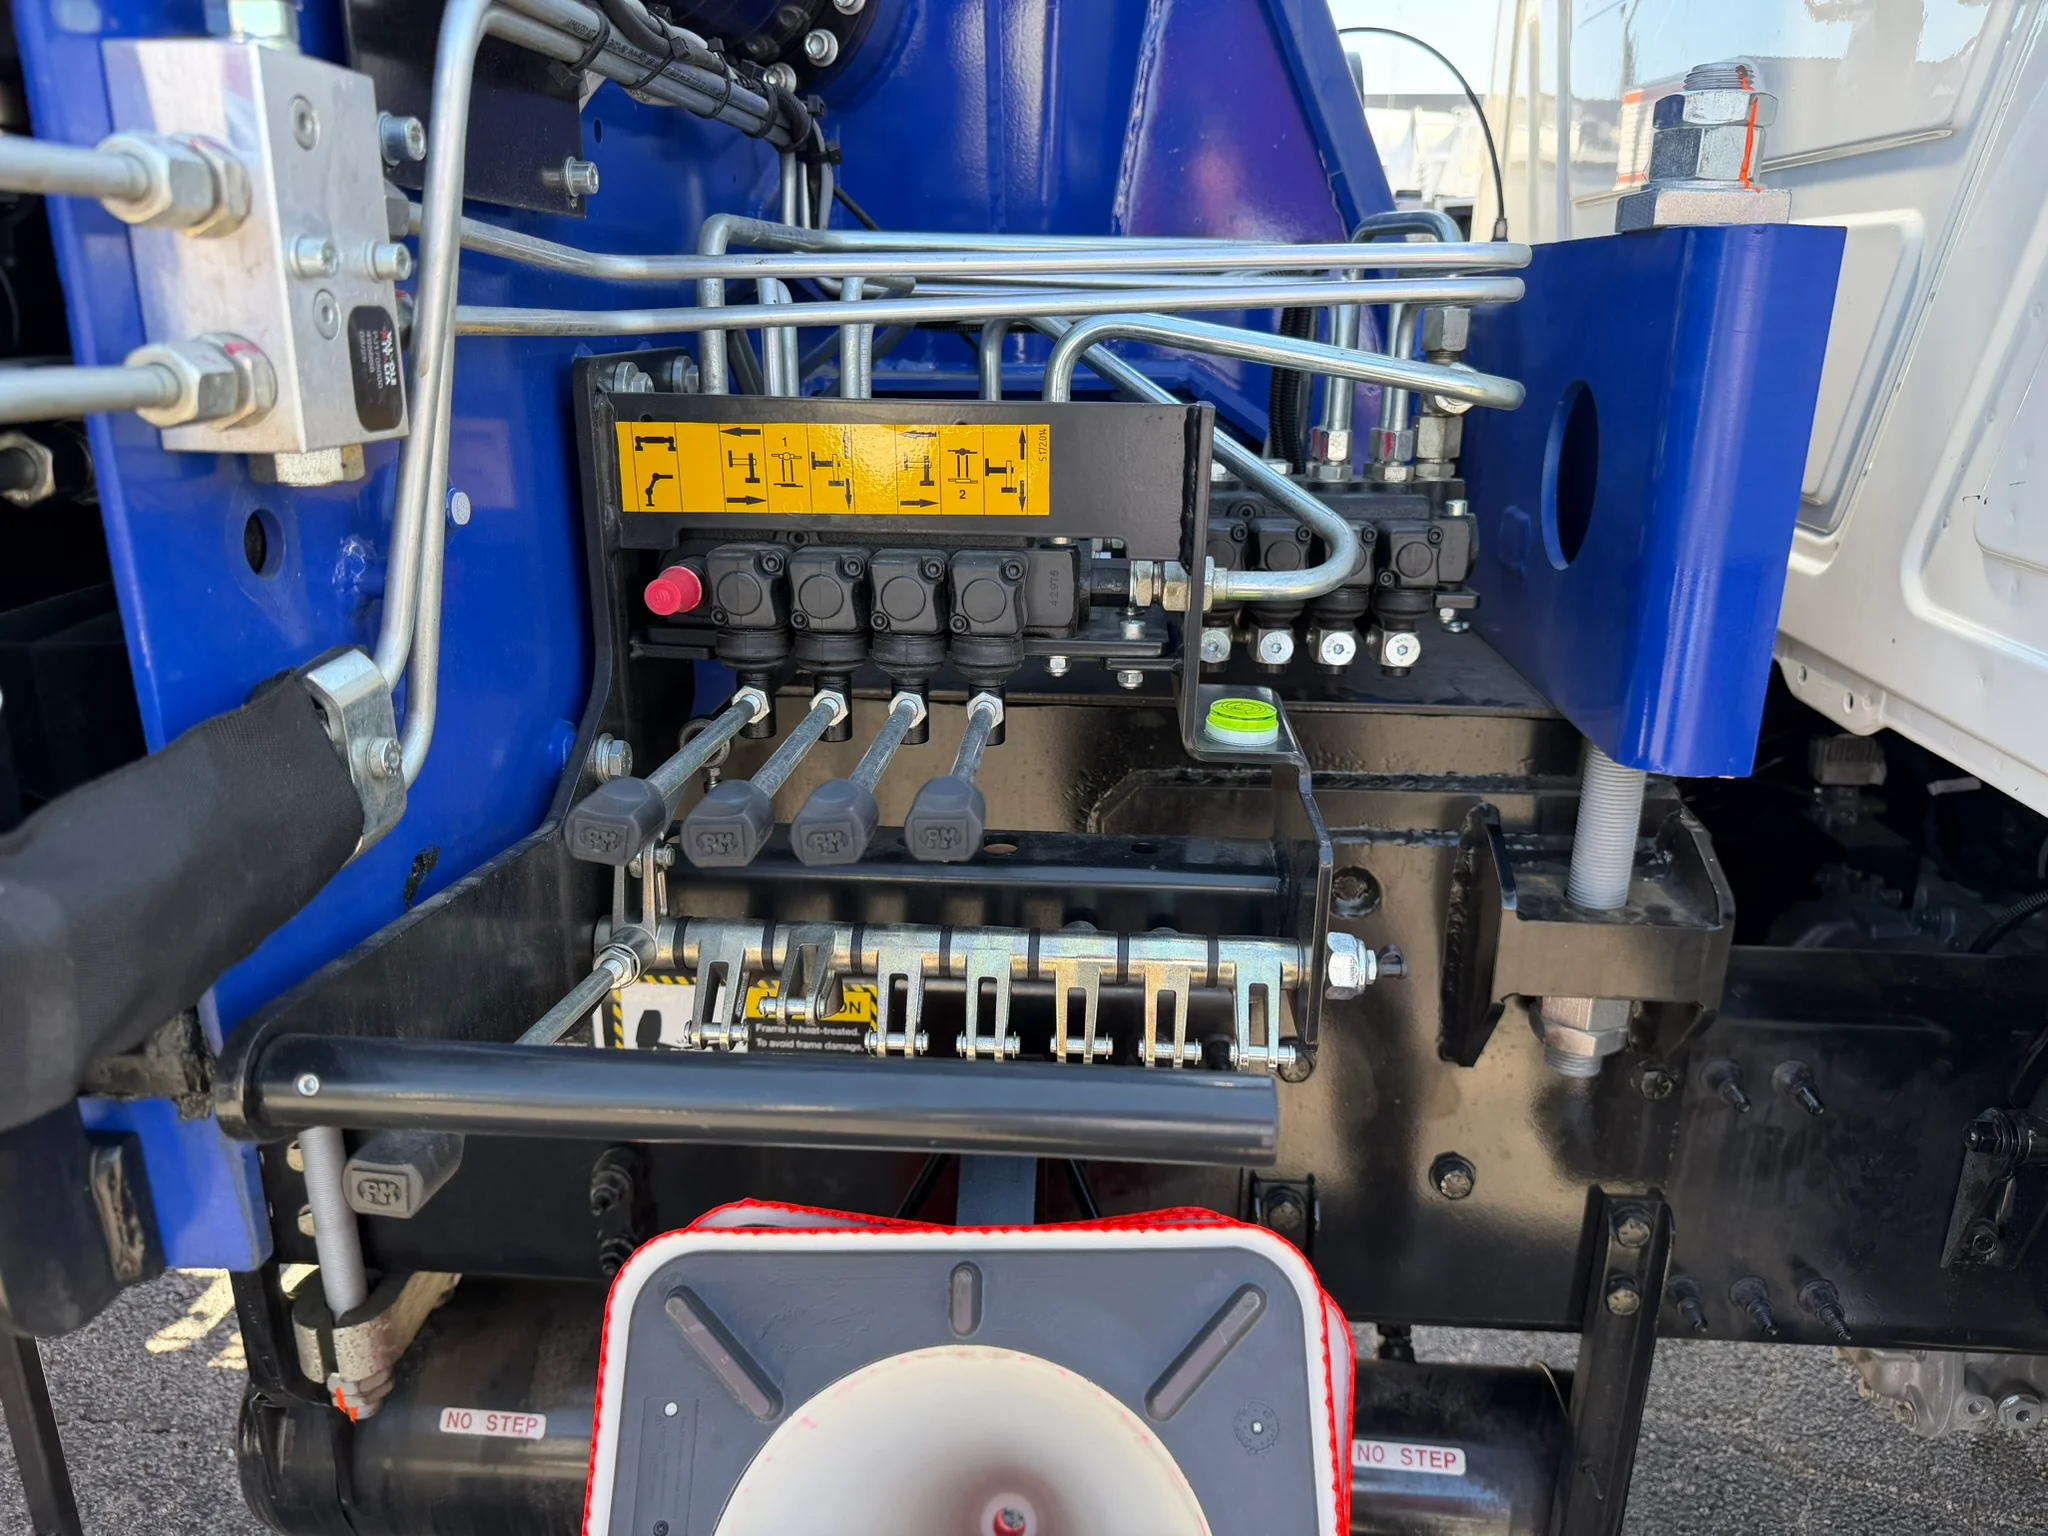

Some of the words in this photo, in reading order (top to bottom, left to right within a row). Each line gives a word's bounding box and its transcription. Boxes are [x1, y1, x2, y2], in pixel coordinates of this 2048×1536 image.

[959, 490, 967, 500] 2
[755, 1023, 787, 1033] Frame
[788, 1025, 797, 1034] is
[798, 1025, 860, 1036] heat-treated.
[756, 1038, 768, 1047] To
[769, 1039, 795, 1049] avoid
[796, 1040, 822, 1050] frame
[446, 1411, 473, 1429] NO
[486, 1414, 538, 1434] STEP
[1357, 1444, 1385, 1463] NO
[1400, 1447, 1457, 1469] STEP
